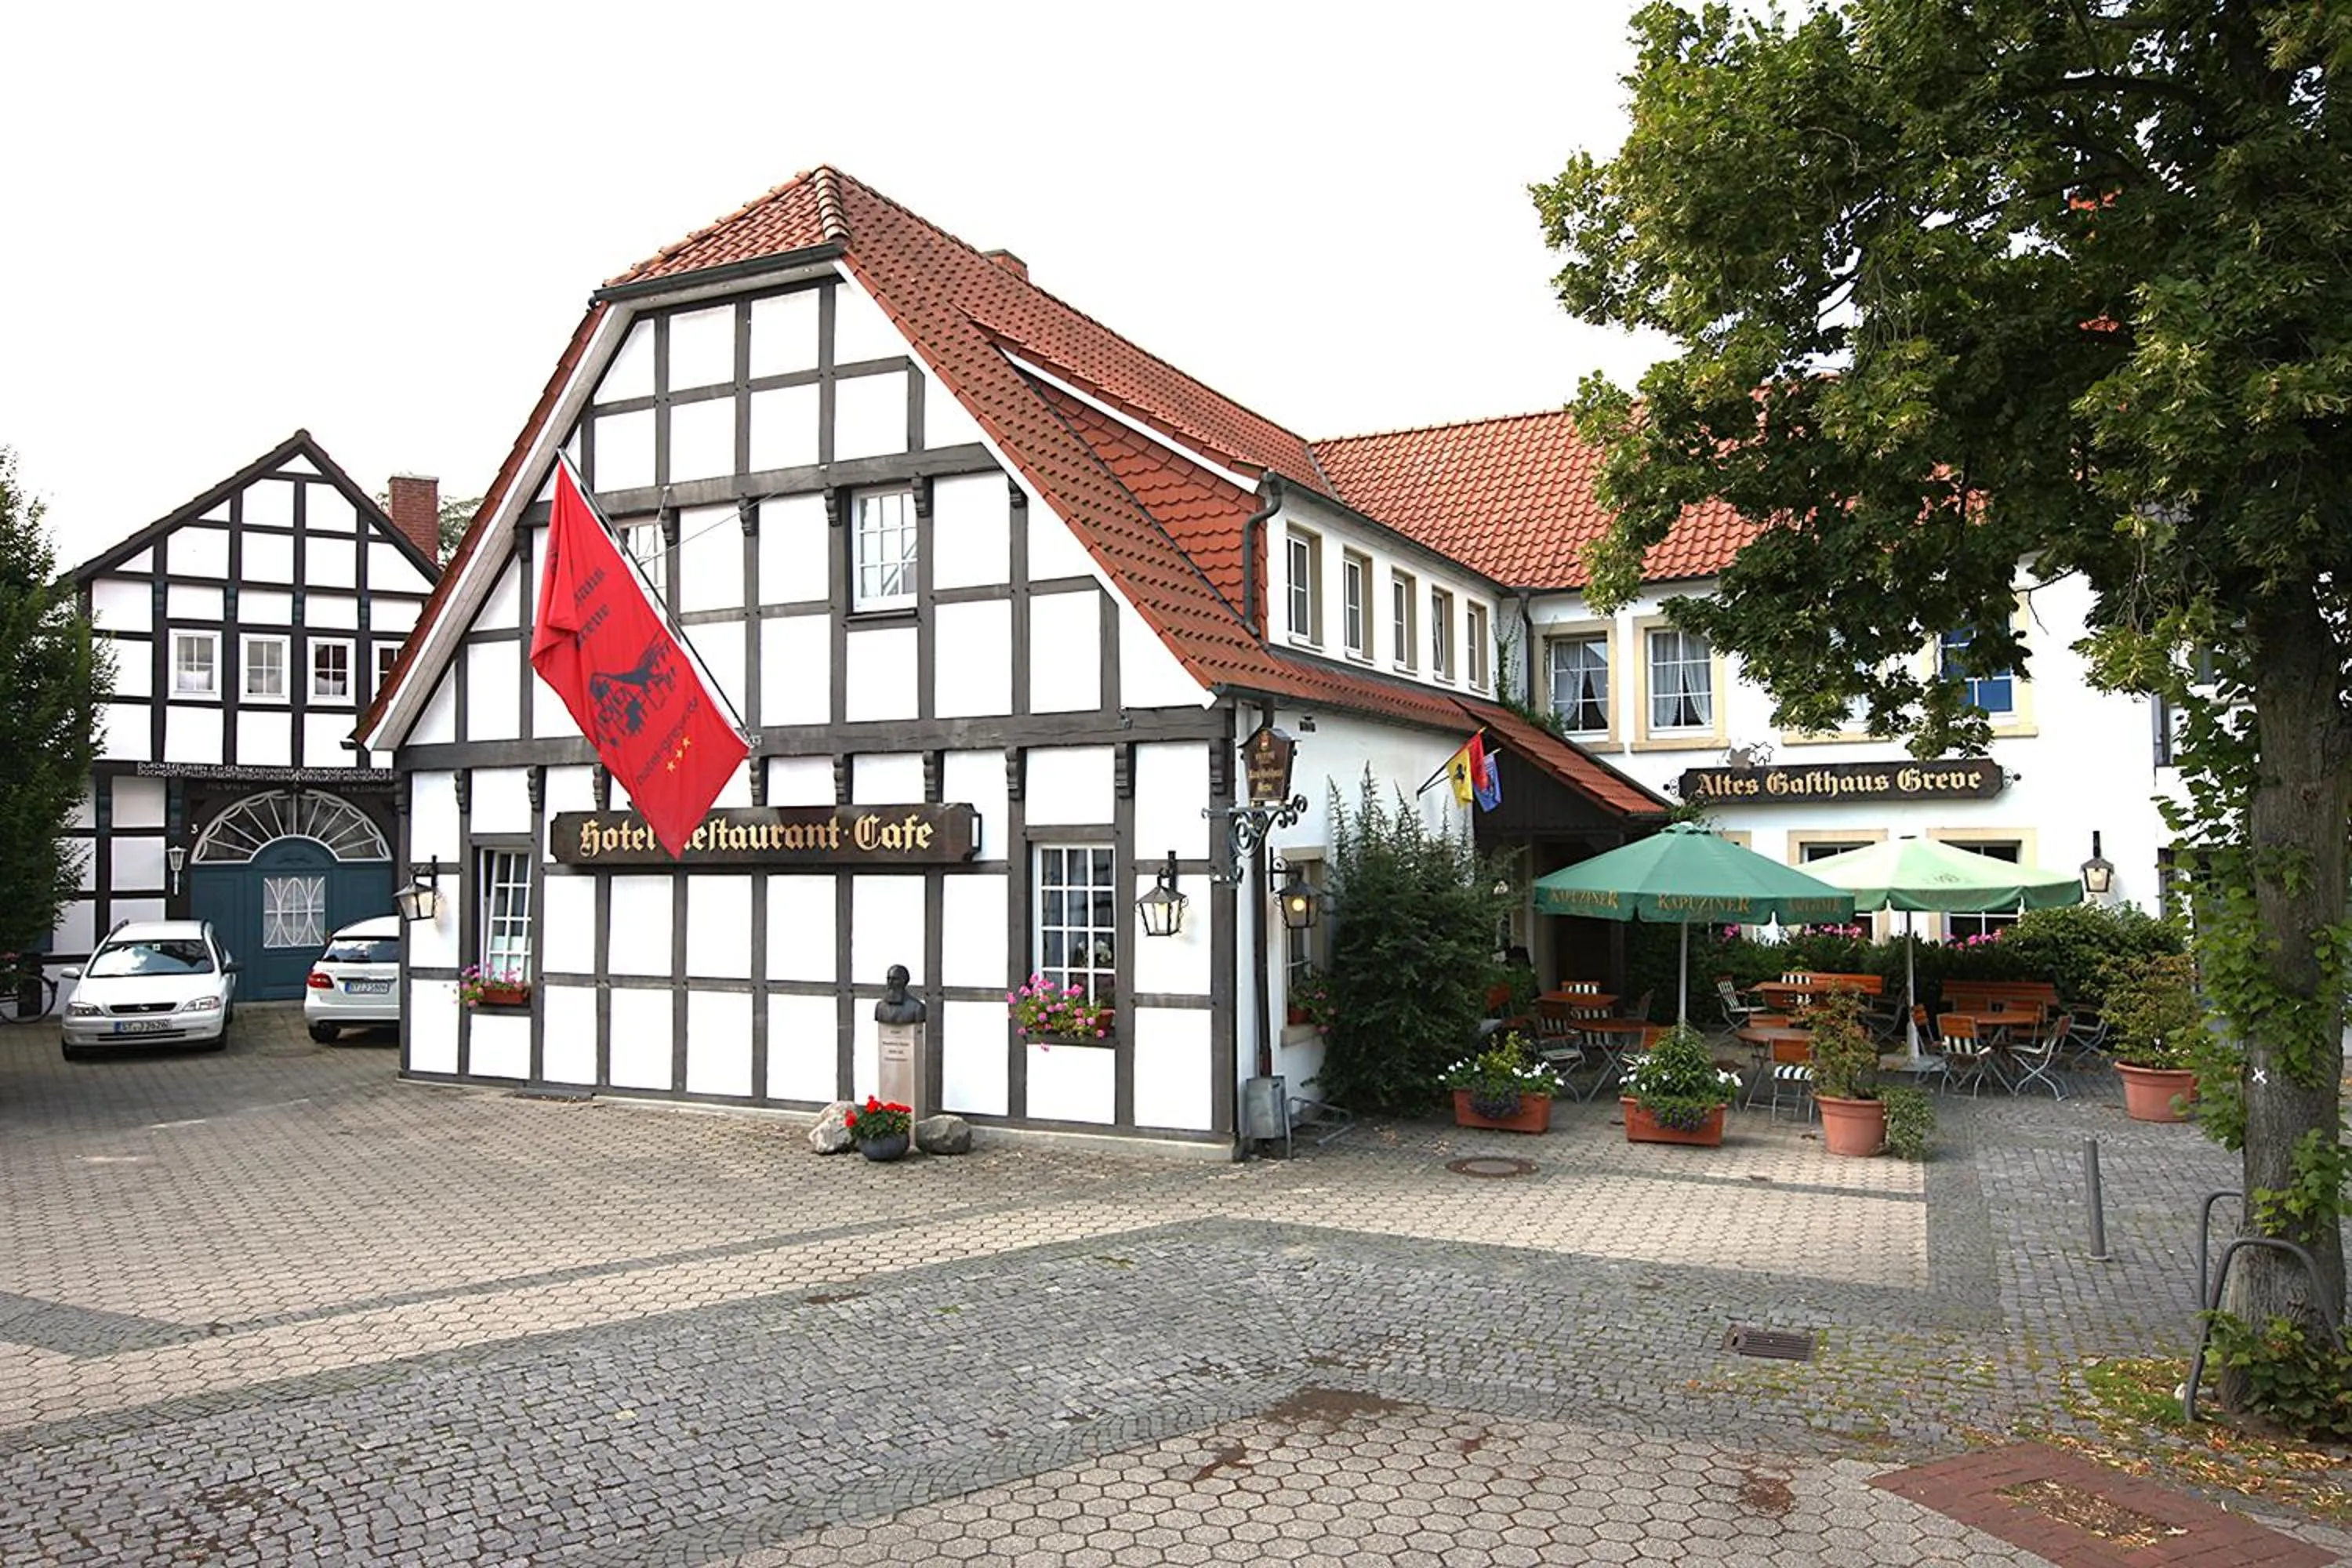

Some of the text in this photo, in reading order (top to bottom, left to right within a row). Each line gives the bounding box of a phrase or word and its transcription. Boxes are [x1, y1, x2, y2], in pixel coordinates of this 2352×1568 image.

[1694, 767, 1983, 798] Altes Gasthaus Greve
[579, 812, 935, 858] Hotel estaurant Cafe
[1657, 891, 1751, 914] KAPUZINER
